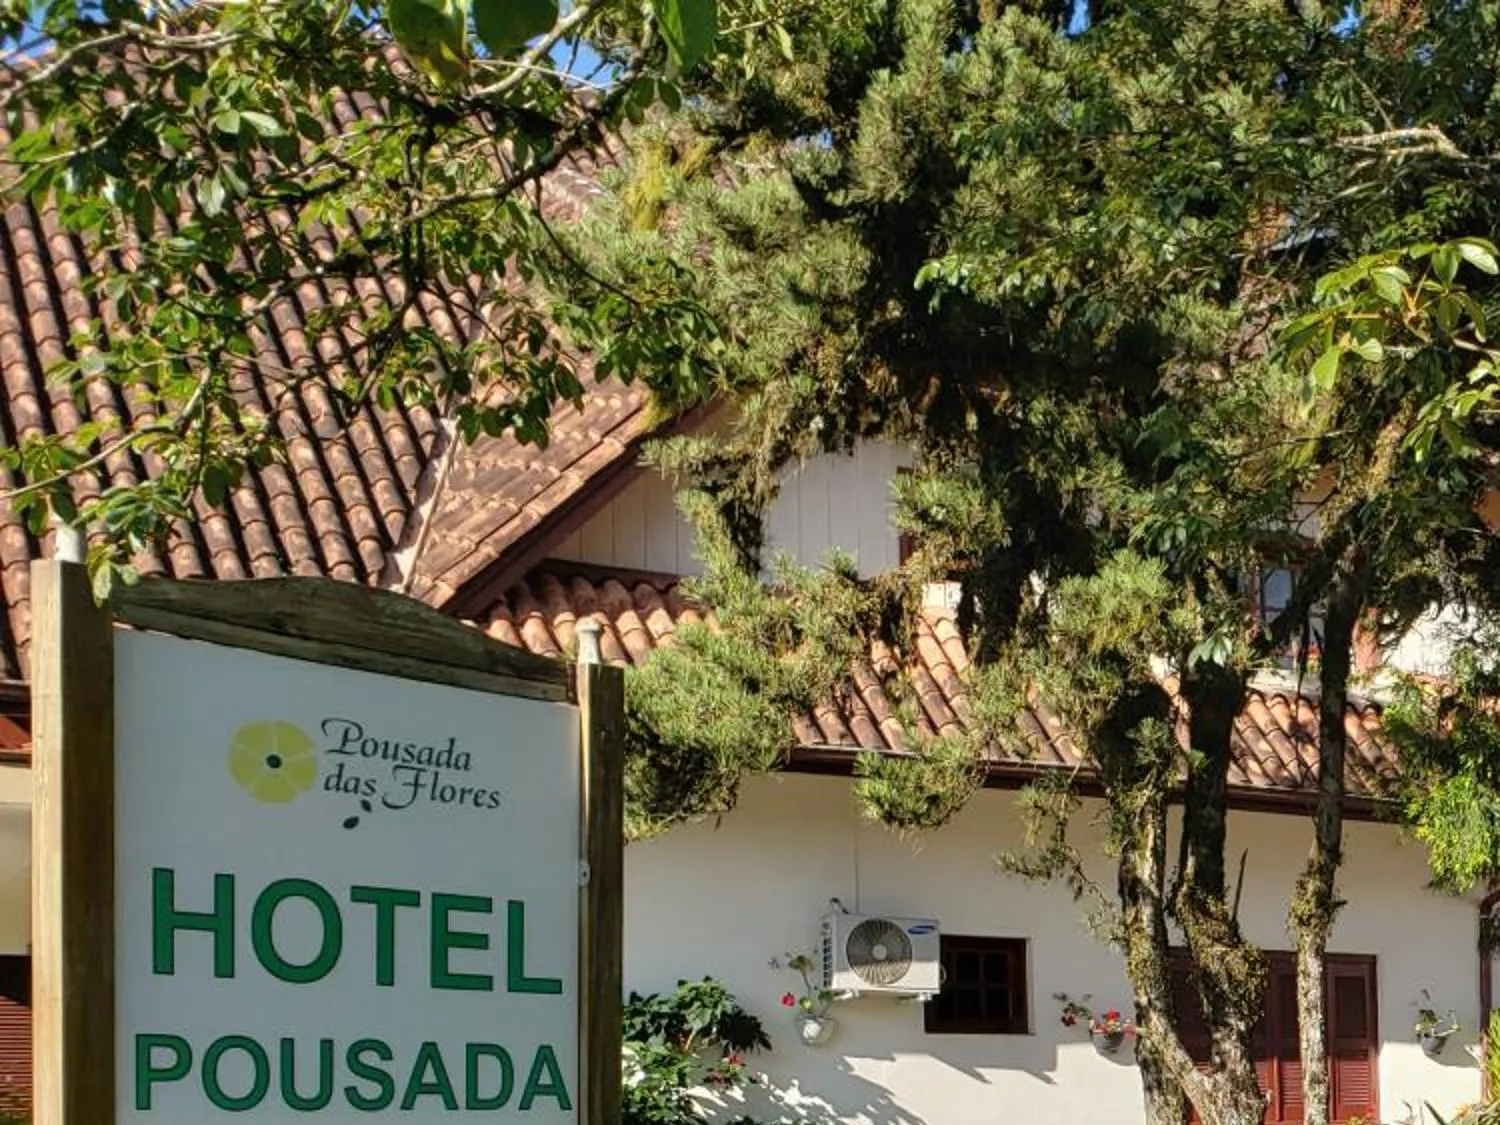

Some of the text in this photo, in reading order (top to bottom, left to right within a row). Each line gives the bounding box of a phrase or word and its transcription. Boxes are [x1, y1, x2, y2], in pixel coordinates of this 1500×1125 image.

[321, 717, 472, 771] Pousada
[324, 763, 500, 809] das Flores
[152, 868, 563, 995] HOTEL
[135, 1033, 573, 1112] POUSADA
